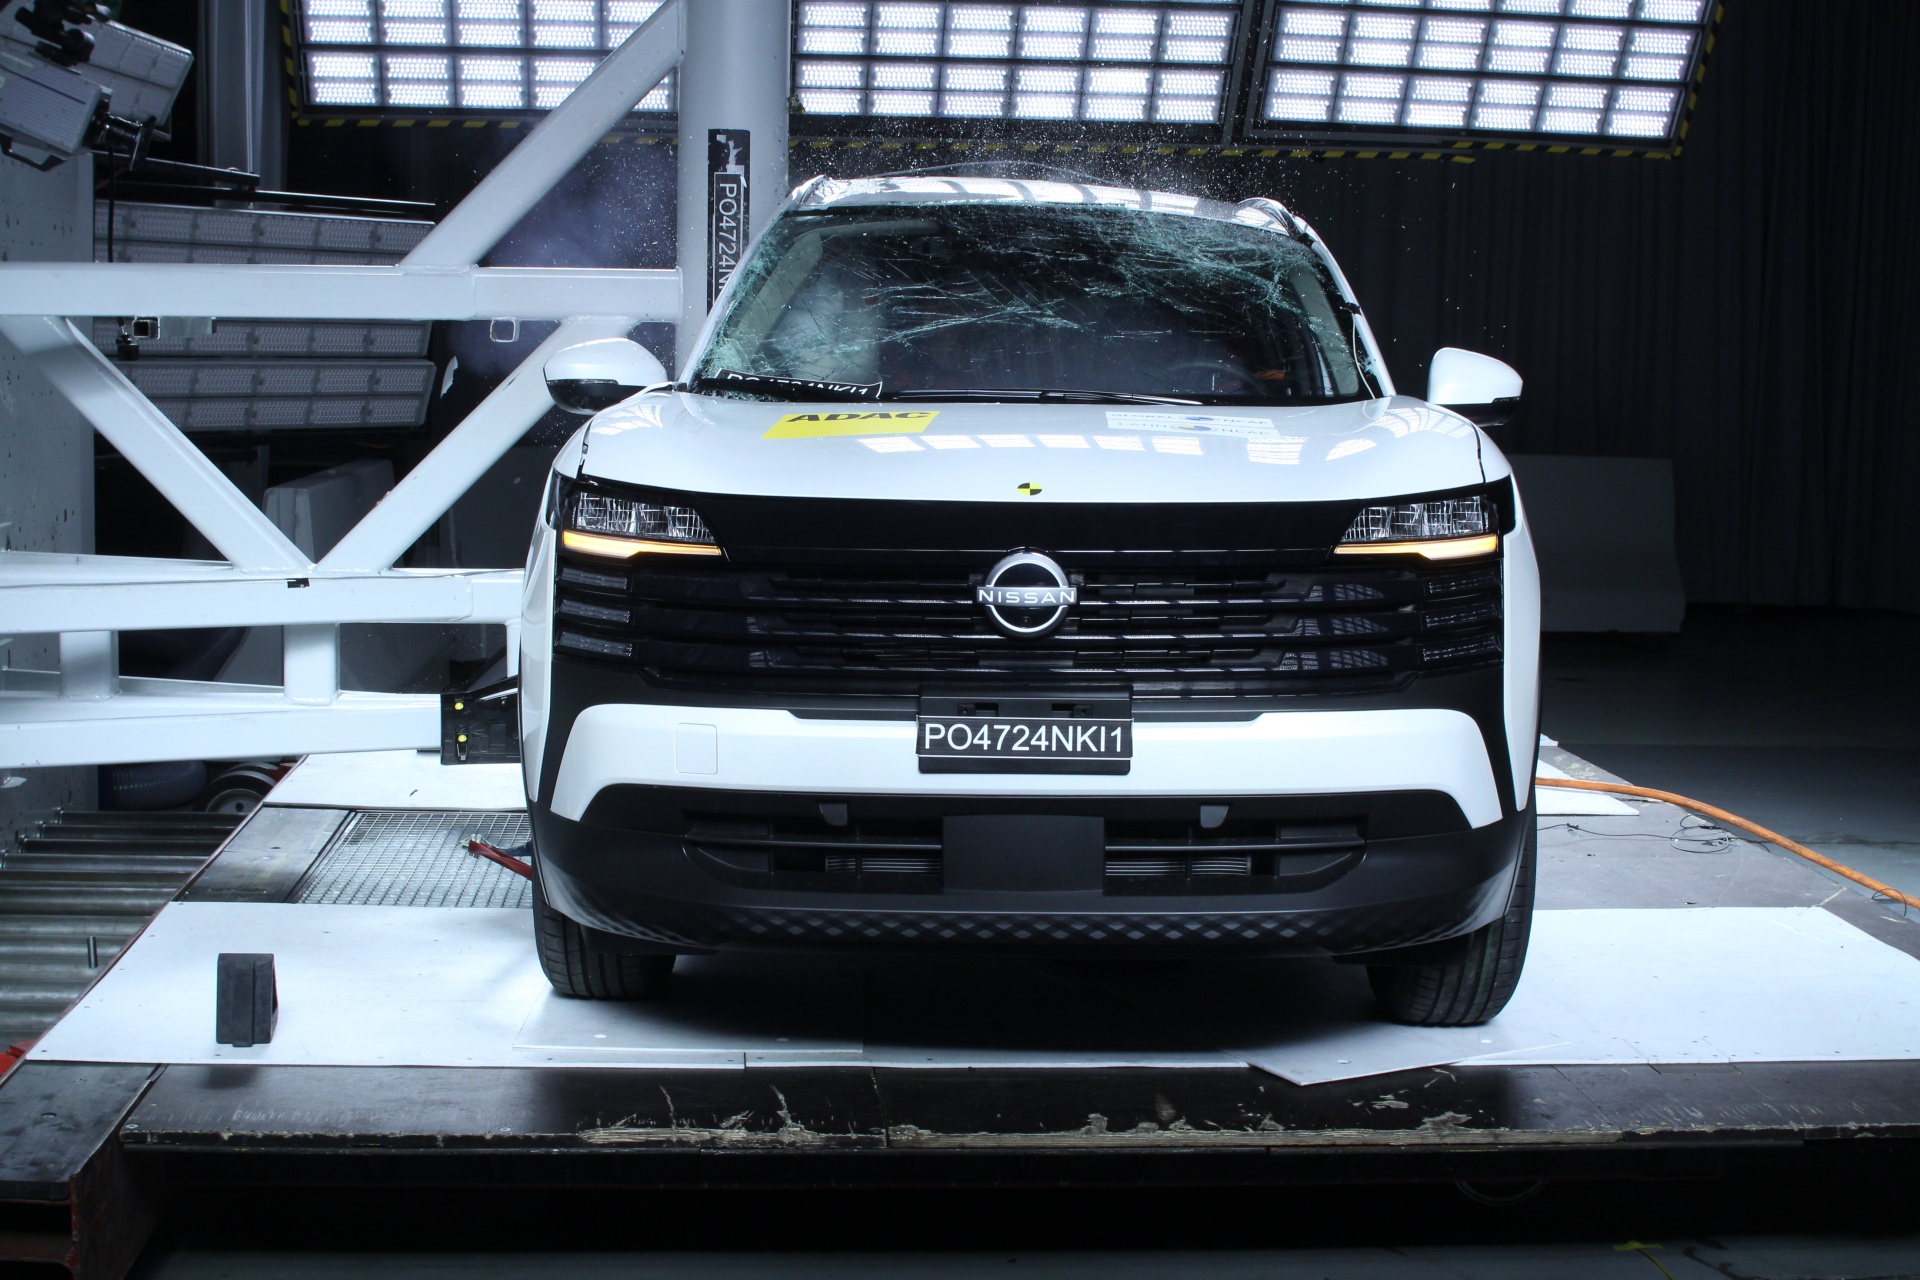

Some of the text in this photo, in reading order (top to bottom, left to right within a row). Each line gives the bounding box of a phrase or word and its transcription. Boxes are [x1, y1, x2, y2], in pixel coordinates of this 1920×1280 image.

[786, 412, 930, 422] ADAC
[978, 589, 1075, 604] NISSAN
[924, 723, 1122, 752] PO4724NKI1
